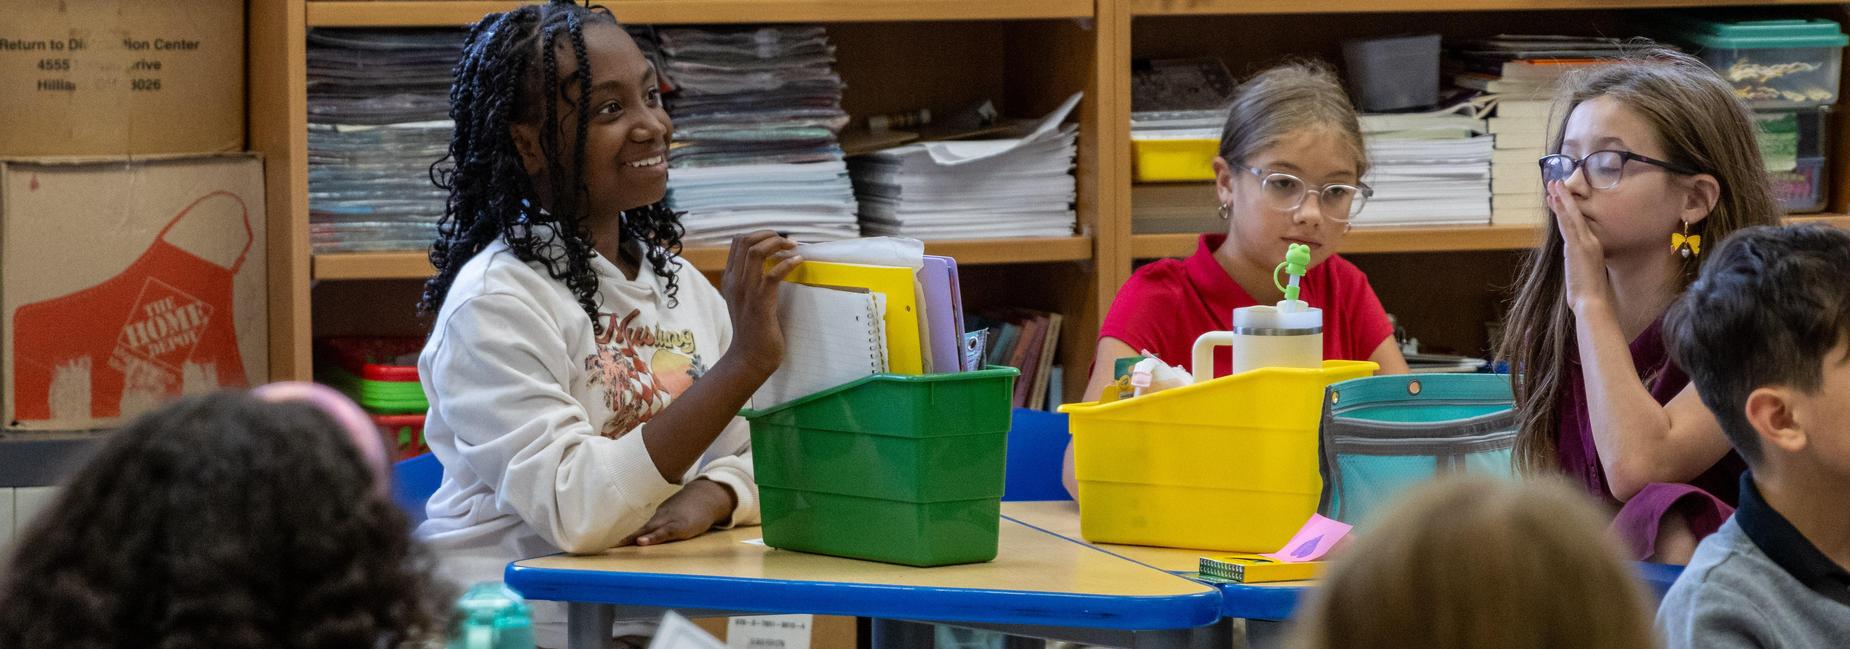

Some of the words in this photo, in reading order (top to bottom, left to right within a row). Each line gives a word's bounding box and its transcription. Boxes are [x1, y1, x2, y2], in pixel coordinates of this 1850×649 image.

[0, 38, 46, 51] Return
[50, 38, 65, 51] to
[154, 38, 199, 51] Center
[37, 59, 71, 71] 4555
[132, 59, 162, 71] rive
[144, 296, 175, 317] THE
[124, 303, 206, 348] HOME
[148, 329, 199, 357] DEPOT
